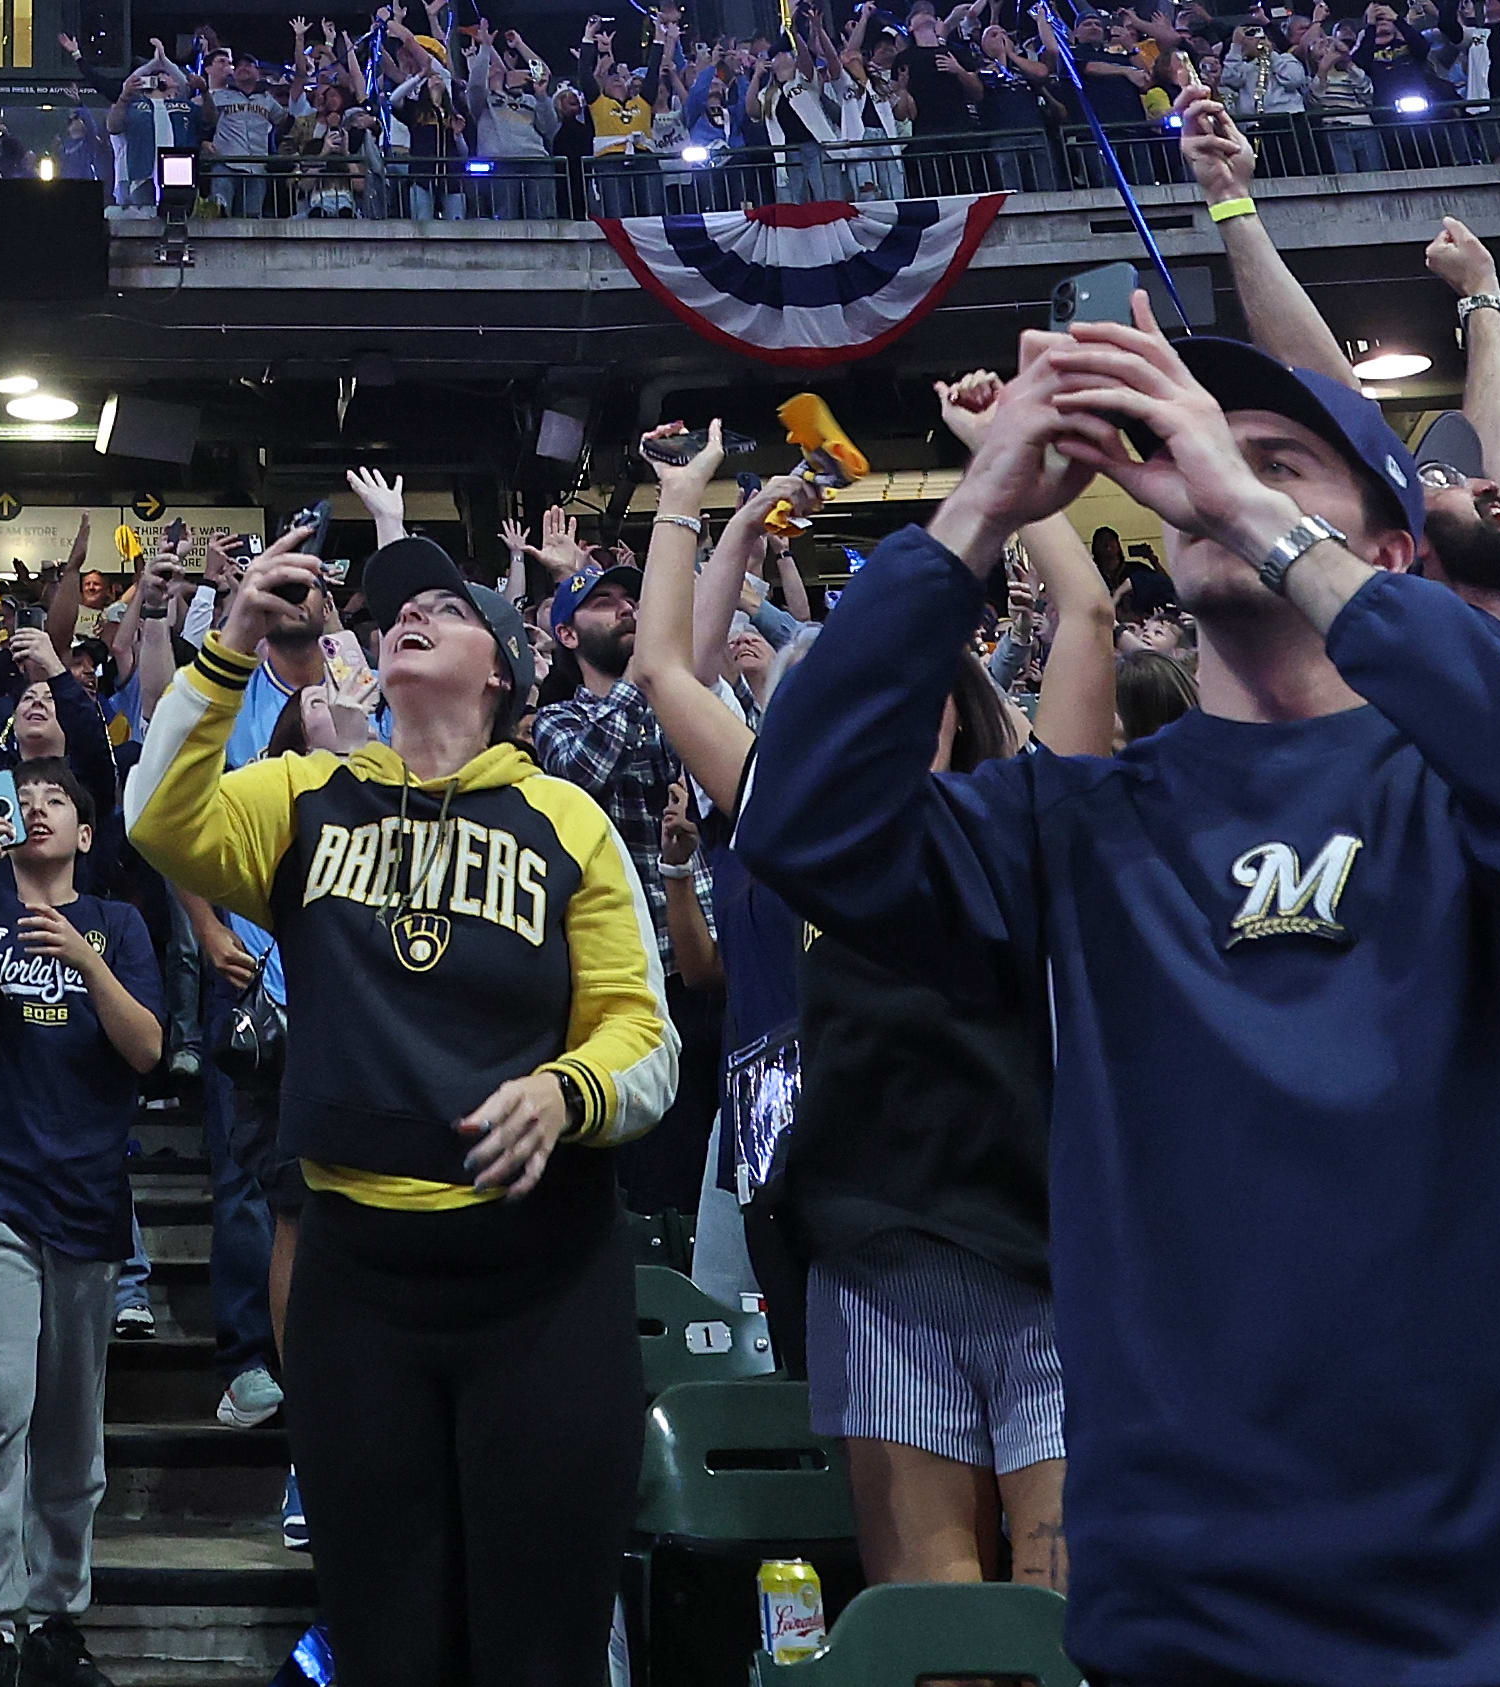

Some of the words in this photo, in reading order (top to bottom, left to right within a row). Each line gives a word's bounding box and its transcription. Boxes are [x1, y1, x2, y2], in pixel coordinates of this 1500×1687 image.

[22, 526, 58, 536] STORE
[302, 815, 549, 947] BREWERS
[1230, 833, 1363, 927] M
[702, 1326, 714, 1350] 1
